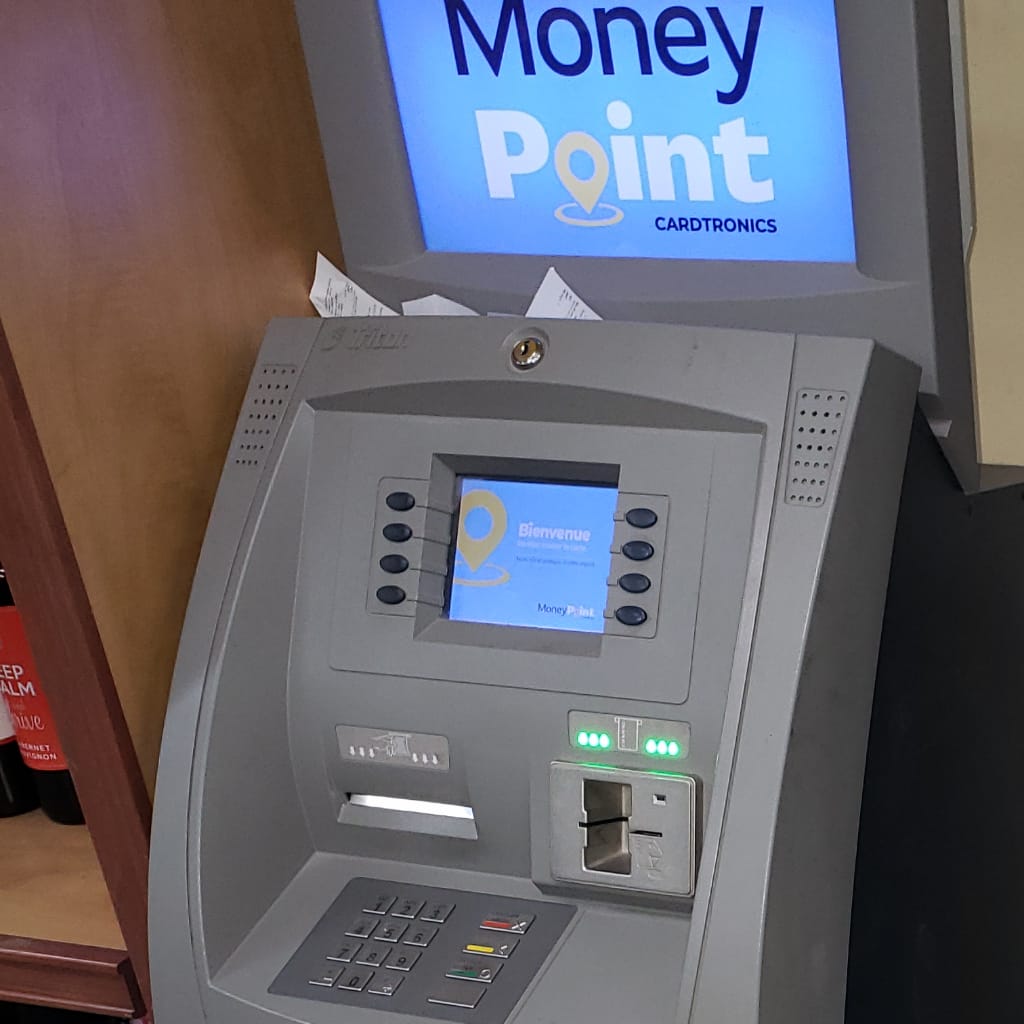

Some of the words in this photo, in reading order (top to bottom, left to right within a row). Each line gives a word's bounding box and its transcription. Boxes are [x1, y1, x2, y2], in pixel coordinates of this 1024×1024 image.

[444, 0, 764, 104] Money
[475, 100, 775, 214] Point
[654, 216, 778, 234] CARDTRONICS
[518, 522, 591, 542] Bienvenue
[1, 680, 37, 697] ALM
